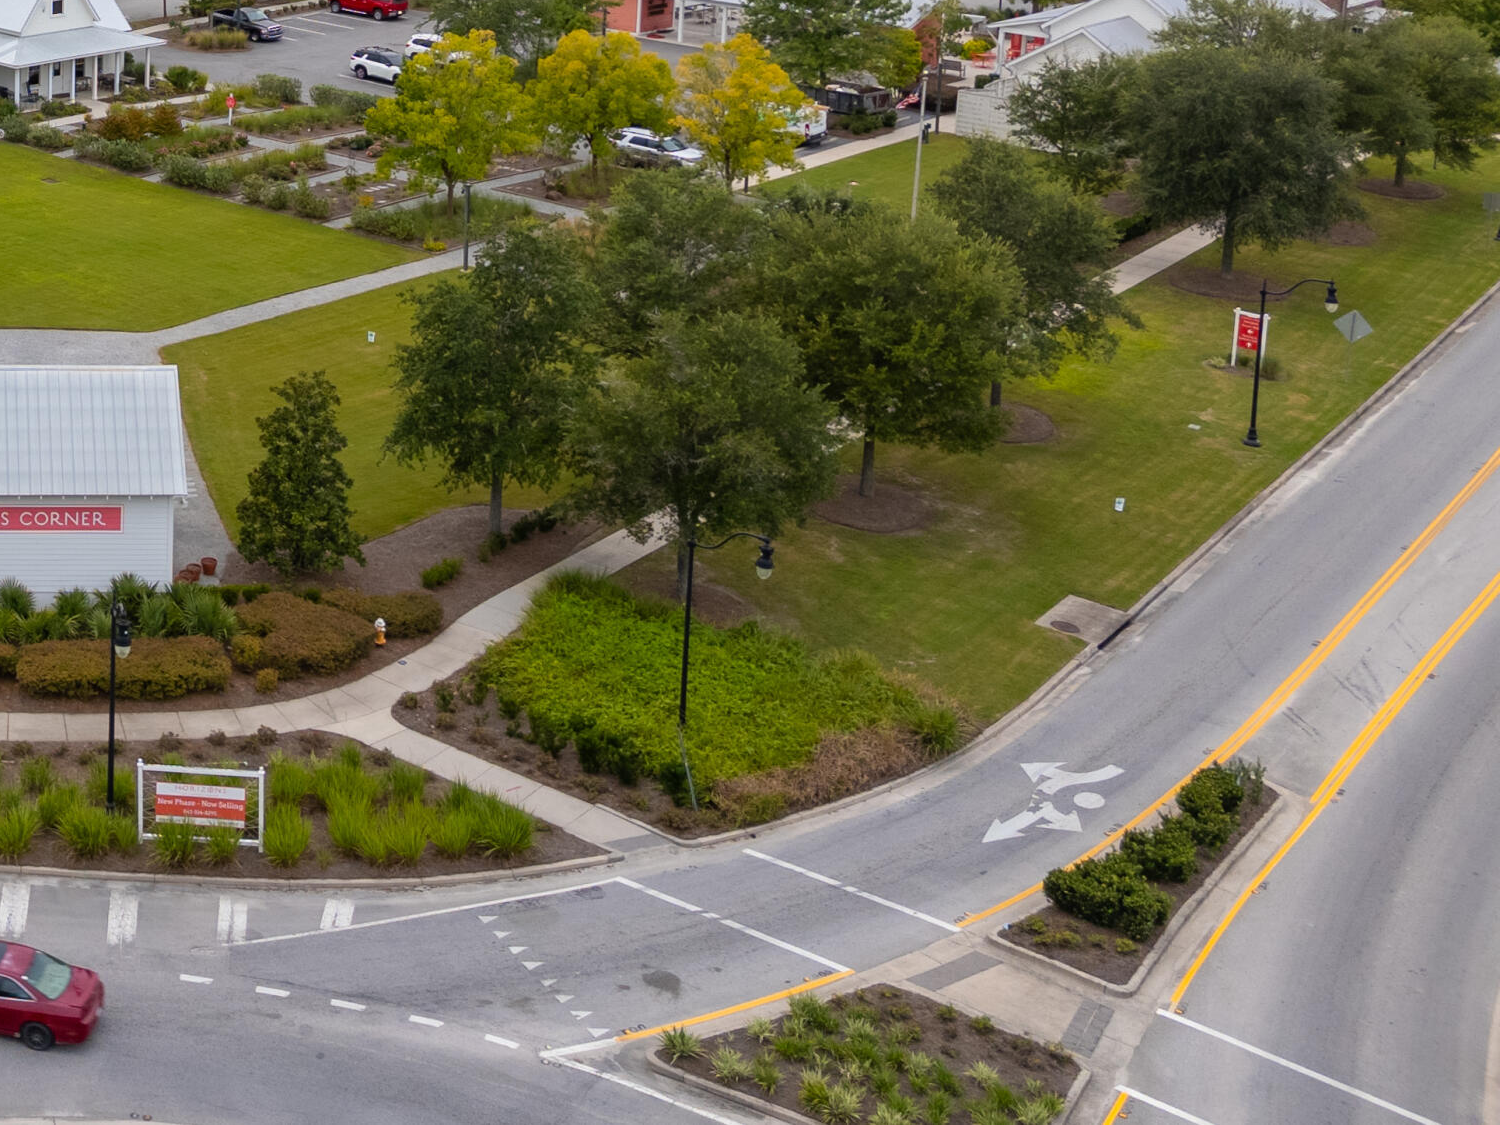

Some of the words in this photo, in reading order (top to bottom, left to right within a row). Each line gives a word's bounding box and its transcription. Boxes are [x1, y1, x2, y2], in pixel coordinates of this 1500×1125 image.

[19, 511, 106, 526] CORNER
[157, 797, 174, 805] New
[175, 798, 196, 806] Phase
[218, 801, 244, 811] Selling
